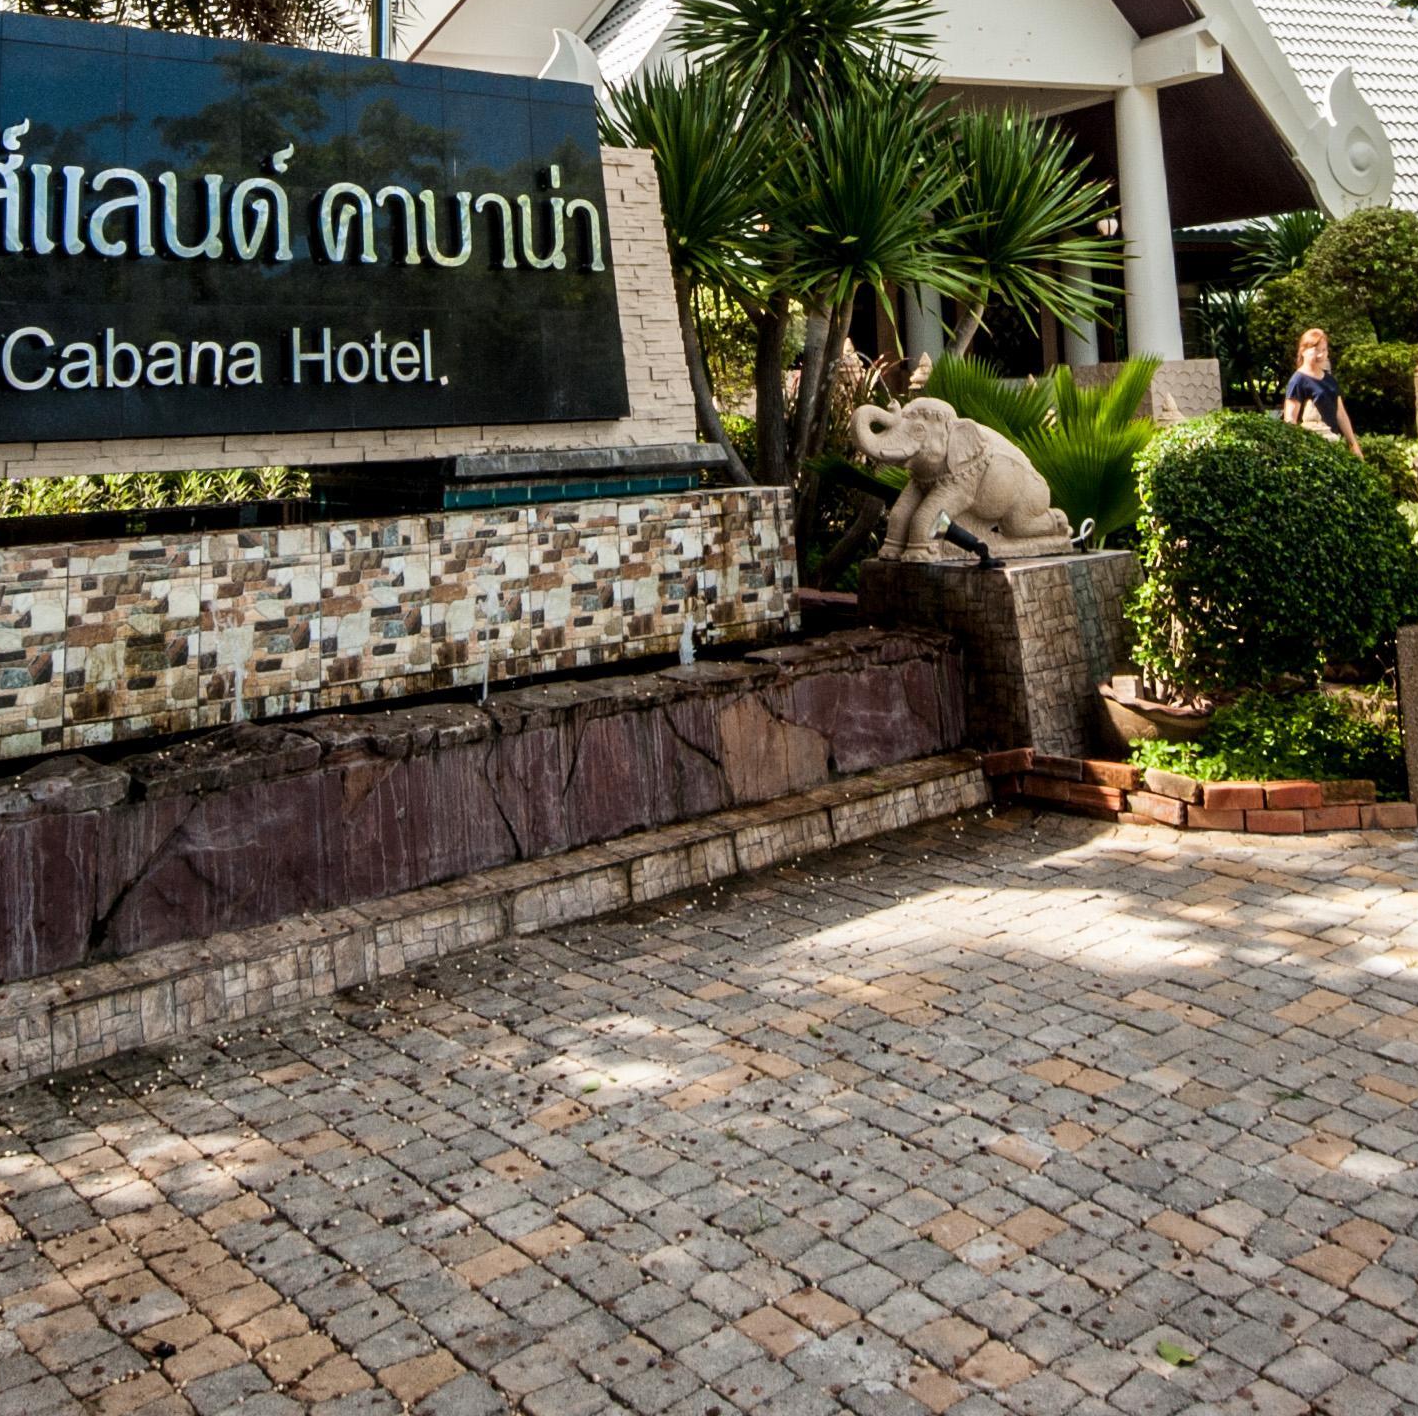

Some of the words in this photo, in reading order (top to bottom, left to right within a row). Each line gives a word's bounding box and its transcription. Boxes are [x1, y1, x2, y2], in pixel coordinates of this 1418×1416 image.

[320, 164, 606, 272] คาบาน่า
[2, 327, 263, 391] Cabana
[292, 327, 449, 385] Hotel.
